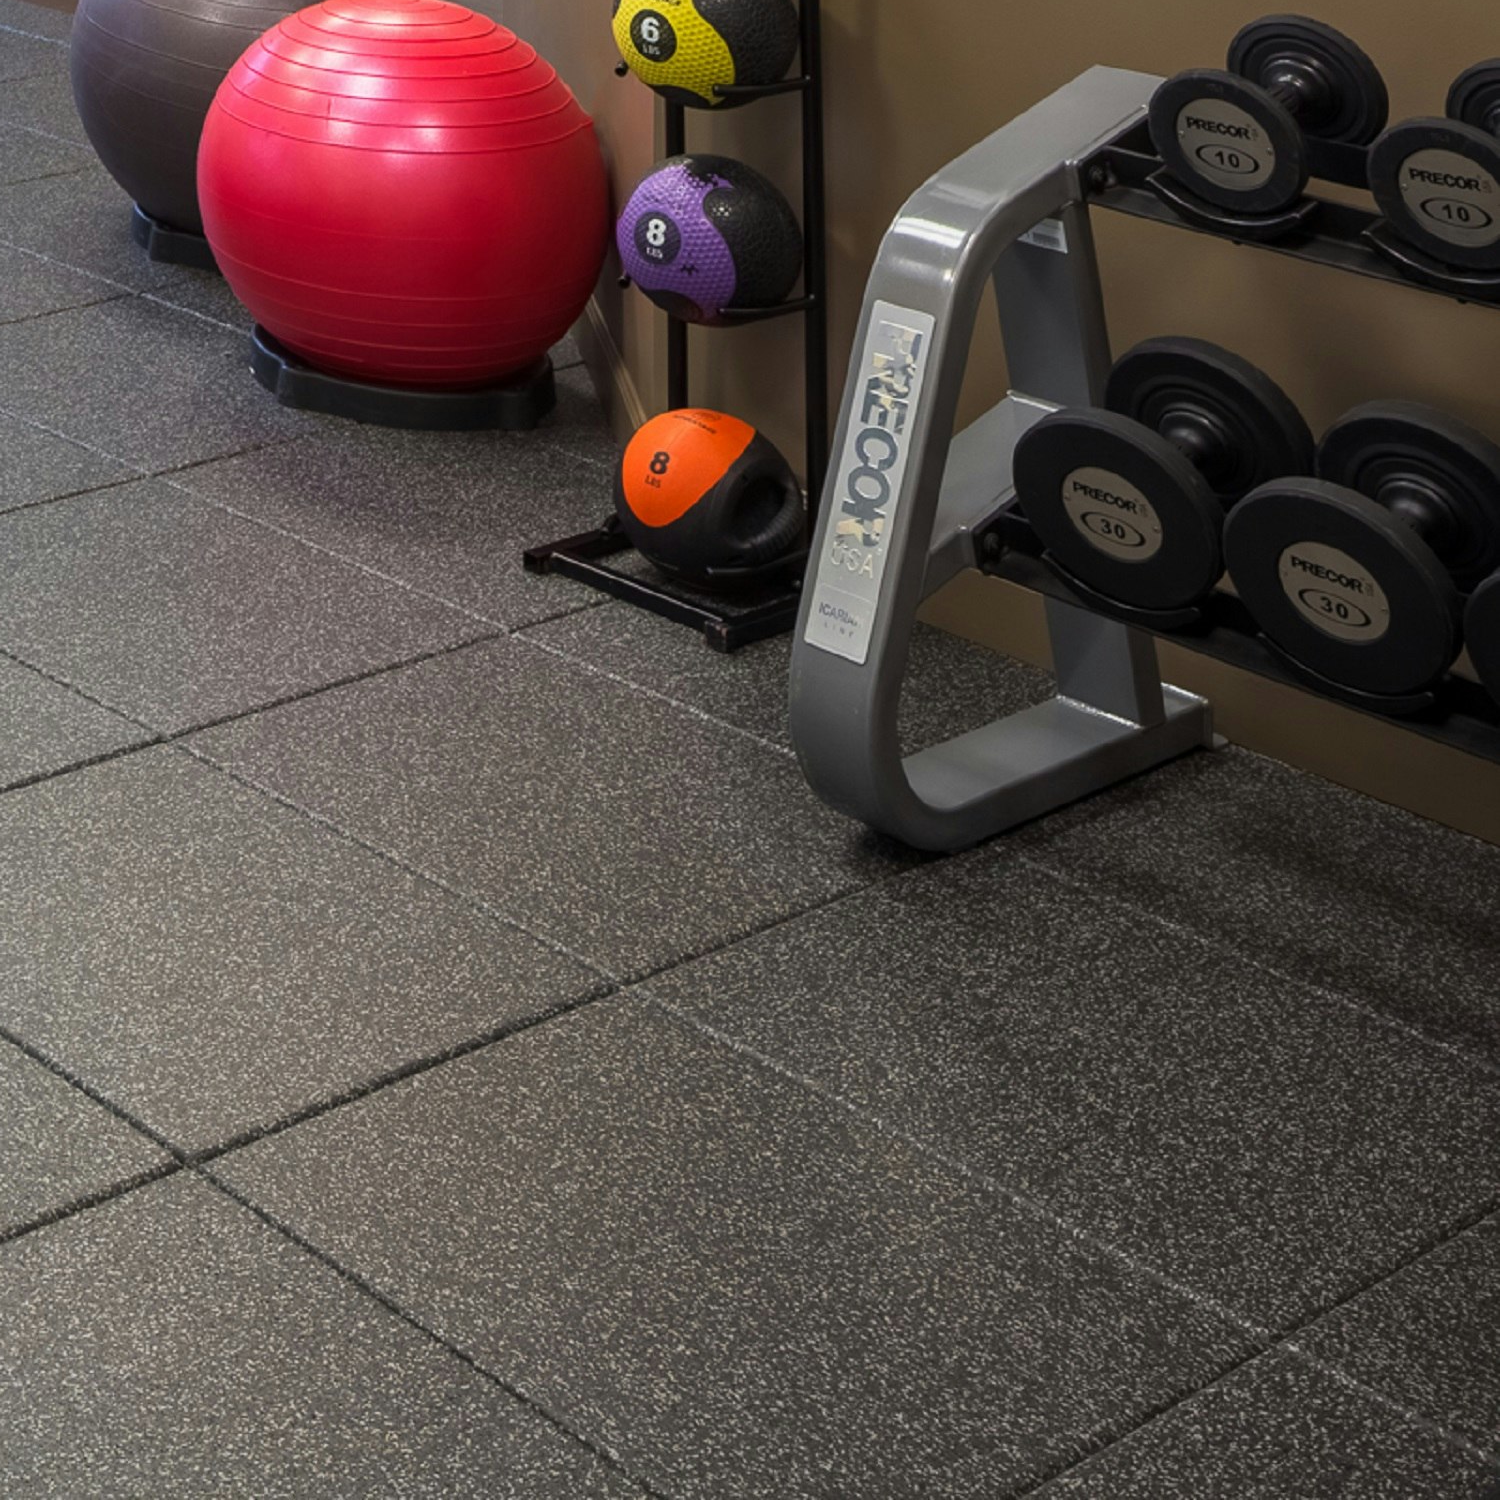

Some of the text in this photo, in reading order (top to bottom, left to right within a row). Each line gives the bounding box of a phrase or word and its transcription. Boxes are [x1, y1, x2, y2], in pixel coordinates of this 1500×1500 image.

[640, 16, 660, 44] 6
[1185, 115, 1251, 141] PRECOR
[1215, 150, 1240, 169] 10
[1408, 167, 1482, 192] PRECOR
[1441, 203, 1470, 222] 10
[646, 218, 667, 247] 8
[649, 450, 671, 476] 8
[1072, 480, 1139, 515] PRECOR
[1100, 518, 1126, 540] 30
[831, 545, 874, 579] USA
[1290, 554, 1364, 594] PRECOR
[1320, 595, 1349, 620] 30
